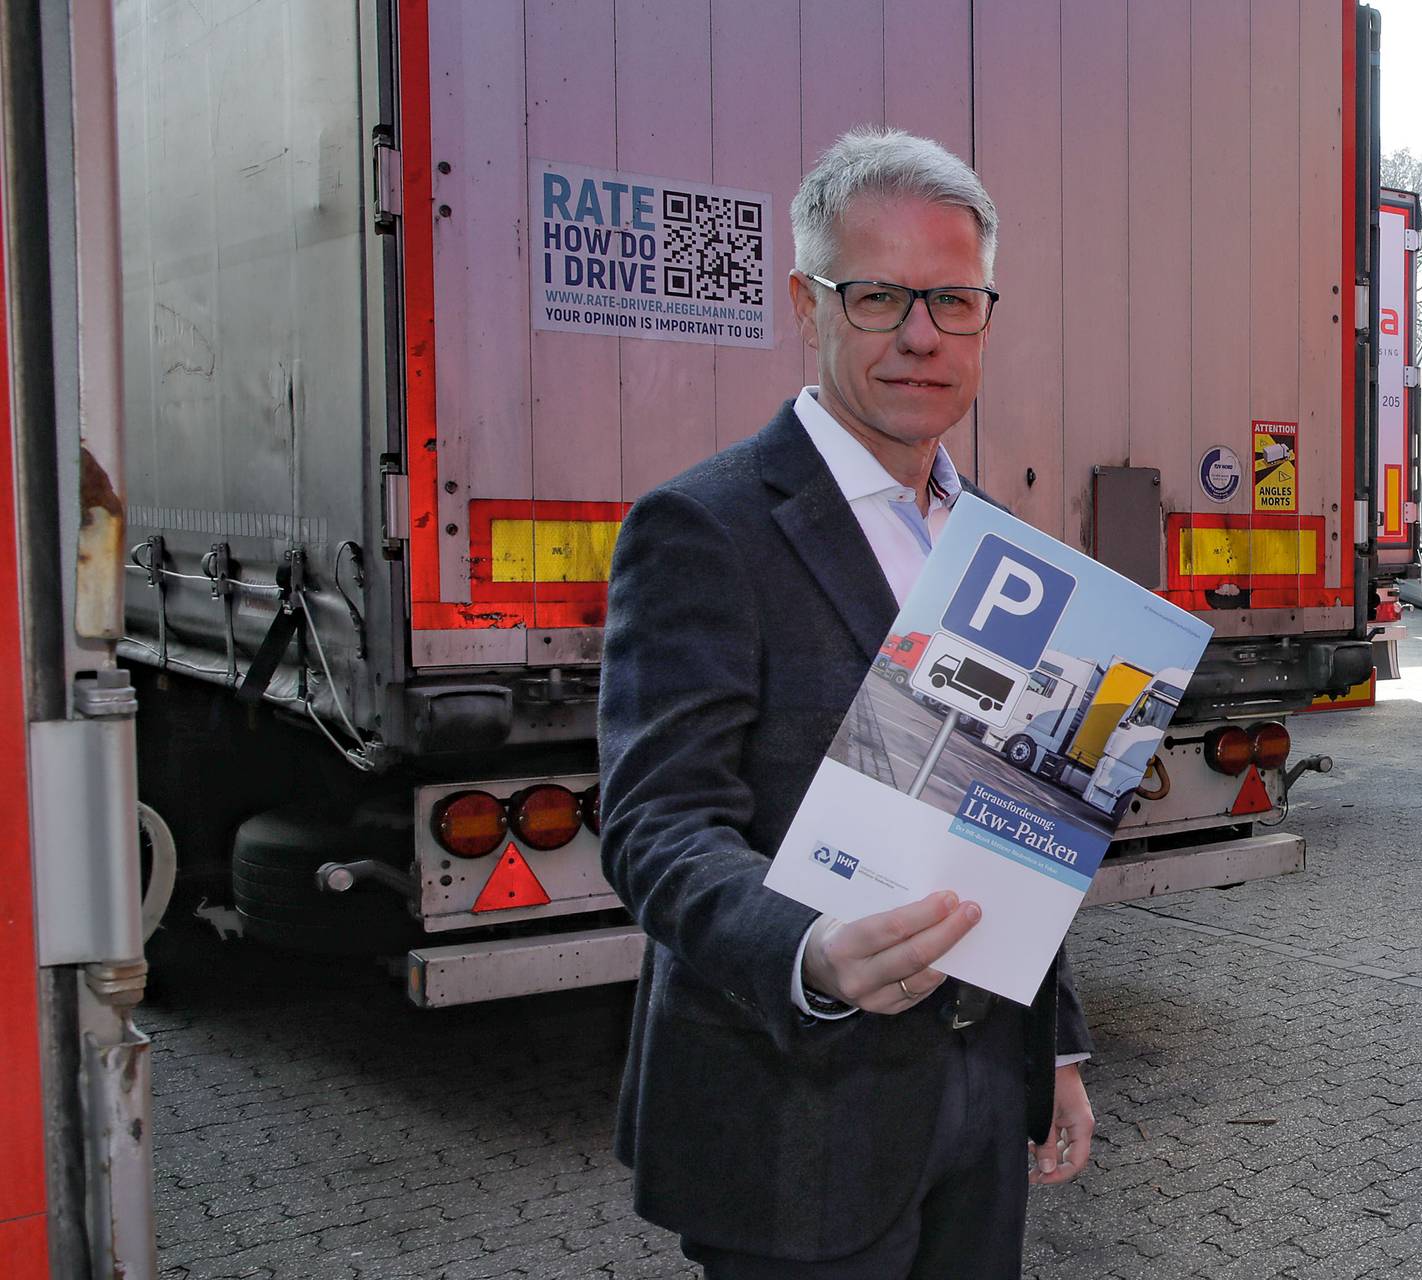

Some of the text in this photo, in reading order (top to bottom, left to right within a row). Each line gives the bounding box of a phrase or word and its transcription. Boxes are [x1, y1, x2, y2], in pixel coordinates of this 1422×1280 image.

[543, 172, 656, 232] RATE
[544, 222, 656, 261] HOW DO
[544, 252, 657, 295] I DRIVE
[545, 289, 763, 322] WWW.RATE-DRIVER.HEGELMANN.COM
[545, 307, 764, 339] YOUR OPINION IS IMPORTANT TO US!
[1382, 395, 1401, 408] 205
[1255, 424, 1296, 434] ATTENTION
[1260, 487, 1292, 496] ANGLES
[1261, 497, 1290, 506] MORTS
[968, 555, 1045, 632] P
[973, 785, 1055, 830] Herausforderung:
[963, 798, 1078, 865] Lkw-Parken
[837, 854, 857, 870] IHK
